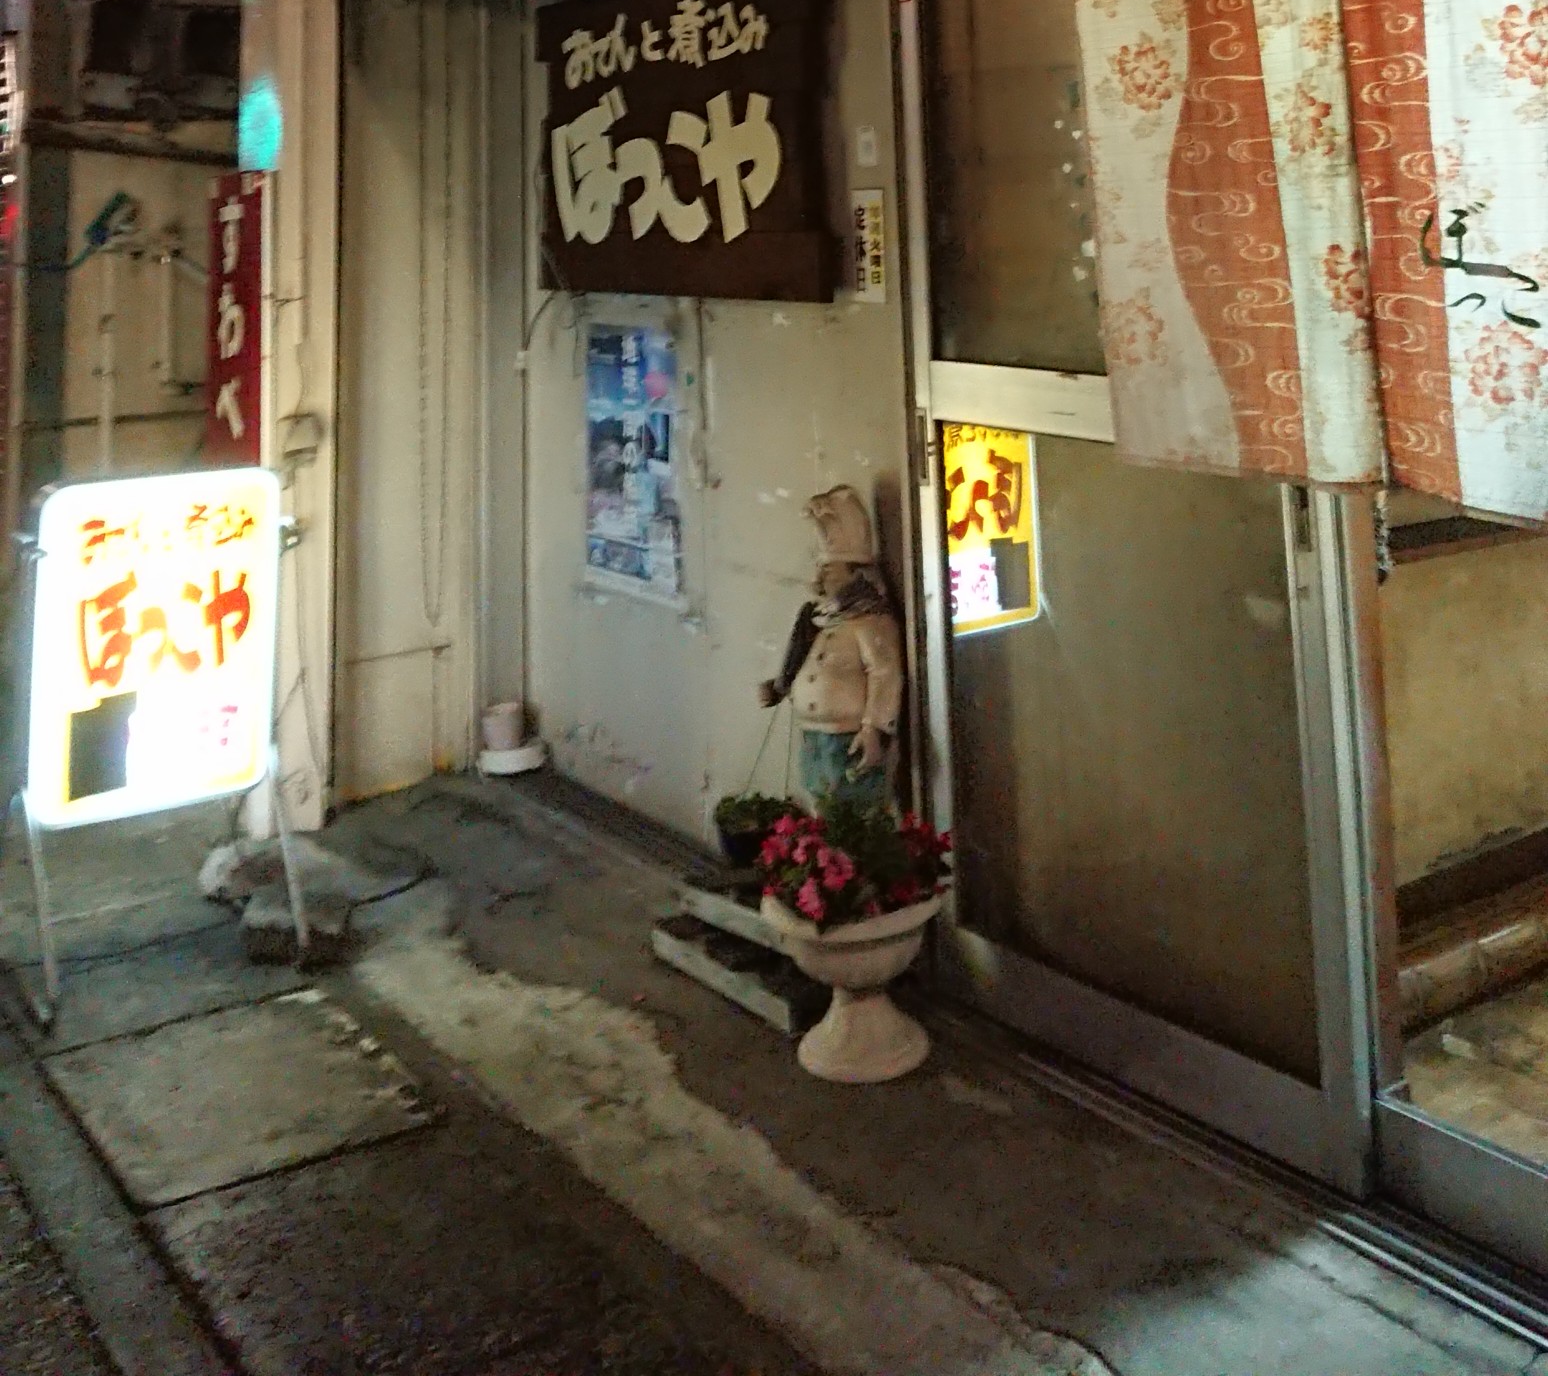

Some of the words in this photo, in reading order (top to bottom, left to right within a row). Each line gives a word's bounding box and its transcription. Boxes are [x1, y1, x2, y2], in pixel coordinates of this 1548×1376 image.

[551, 86, 783, 245] ぼんや
[79, 569, 252, 688] ぼんや
